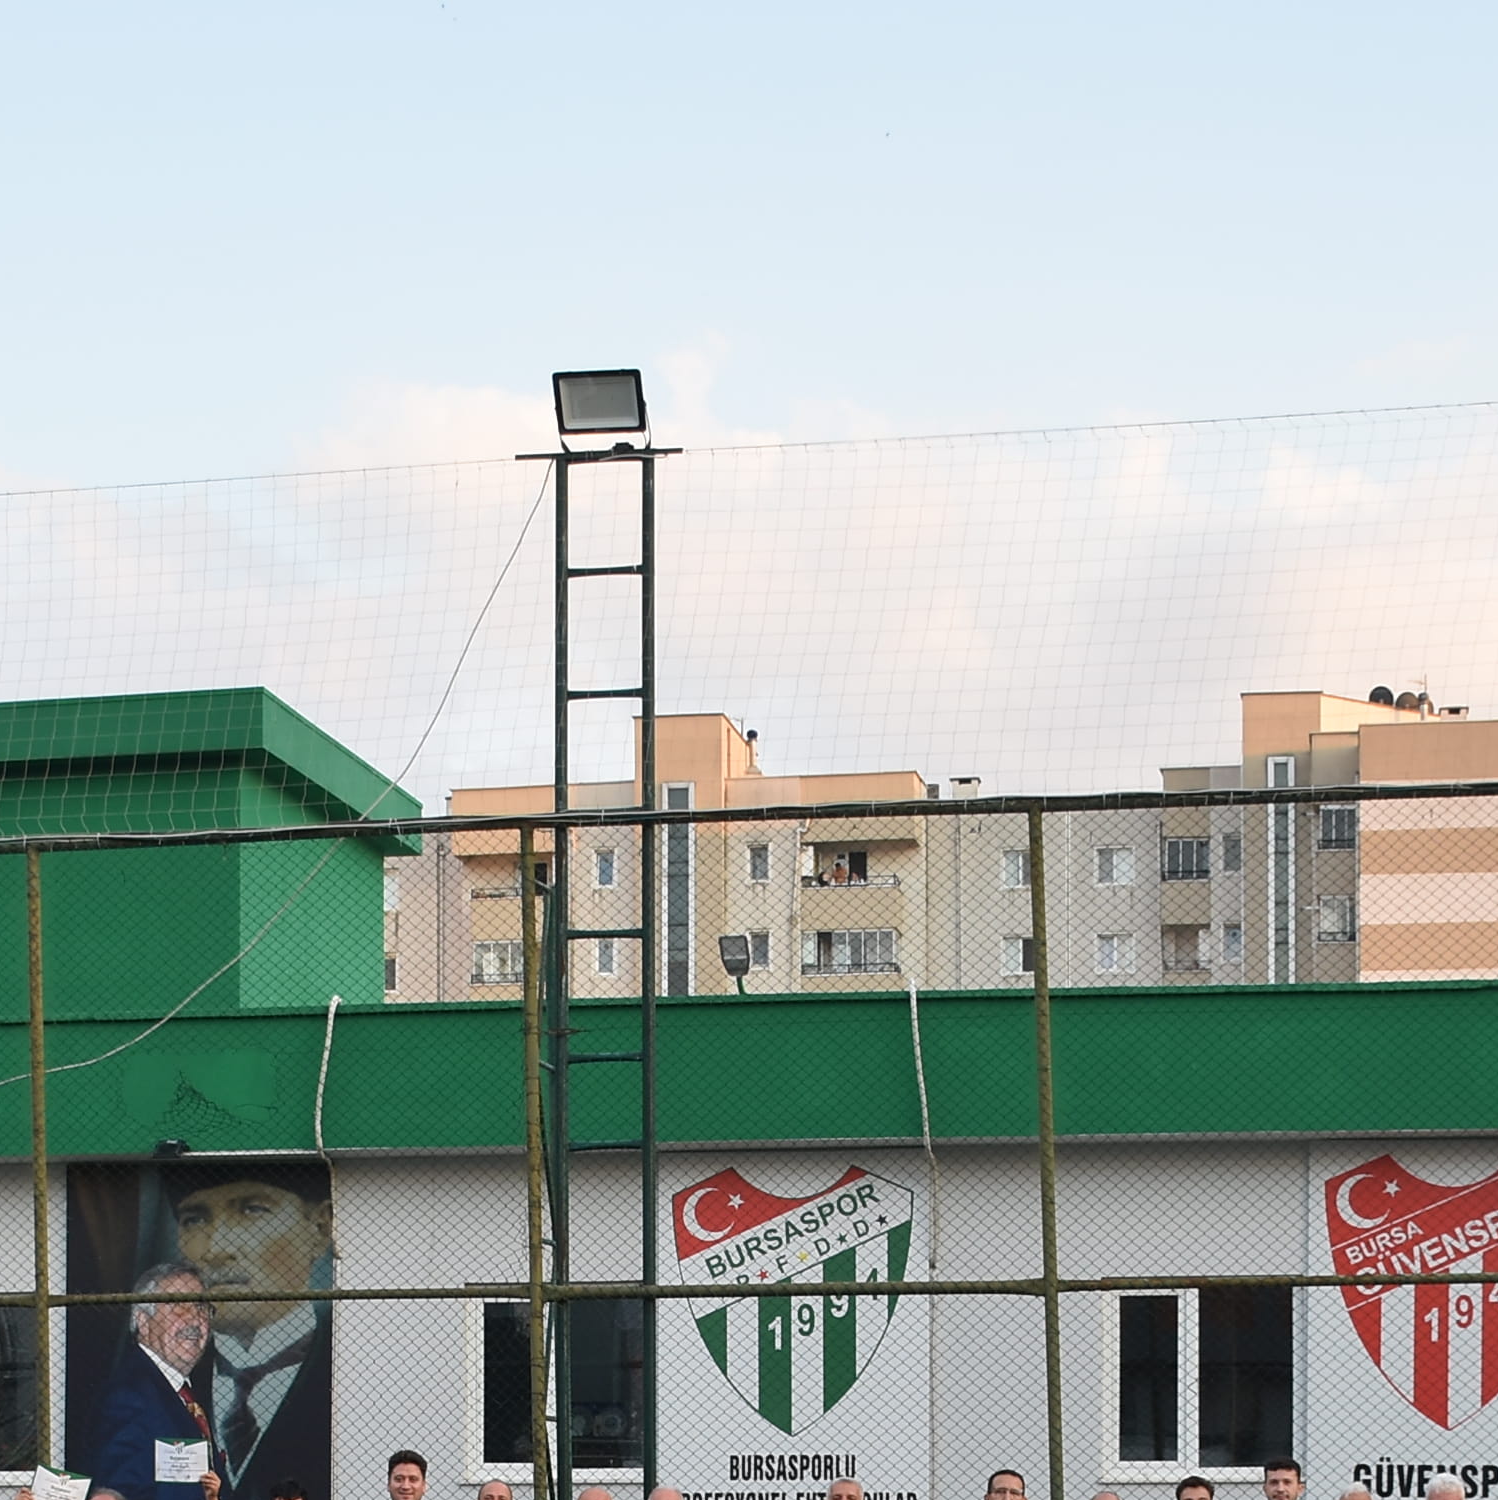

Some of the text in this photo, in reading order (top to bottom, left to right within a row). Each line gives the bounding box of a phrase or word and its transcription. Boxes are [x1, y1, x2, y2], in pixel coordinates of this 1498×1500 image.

[705, 1184, 880, 1278] BURSASPOR
[775, 1255, 789, 1273] F
[814, 1237, 831, 1256] D
[853, 1219, 870, 1238] D
[1345, 1220, 1424, 1264] BURSA
[729, 1455, 856, 1481] BURSASPORLU
